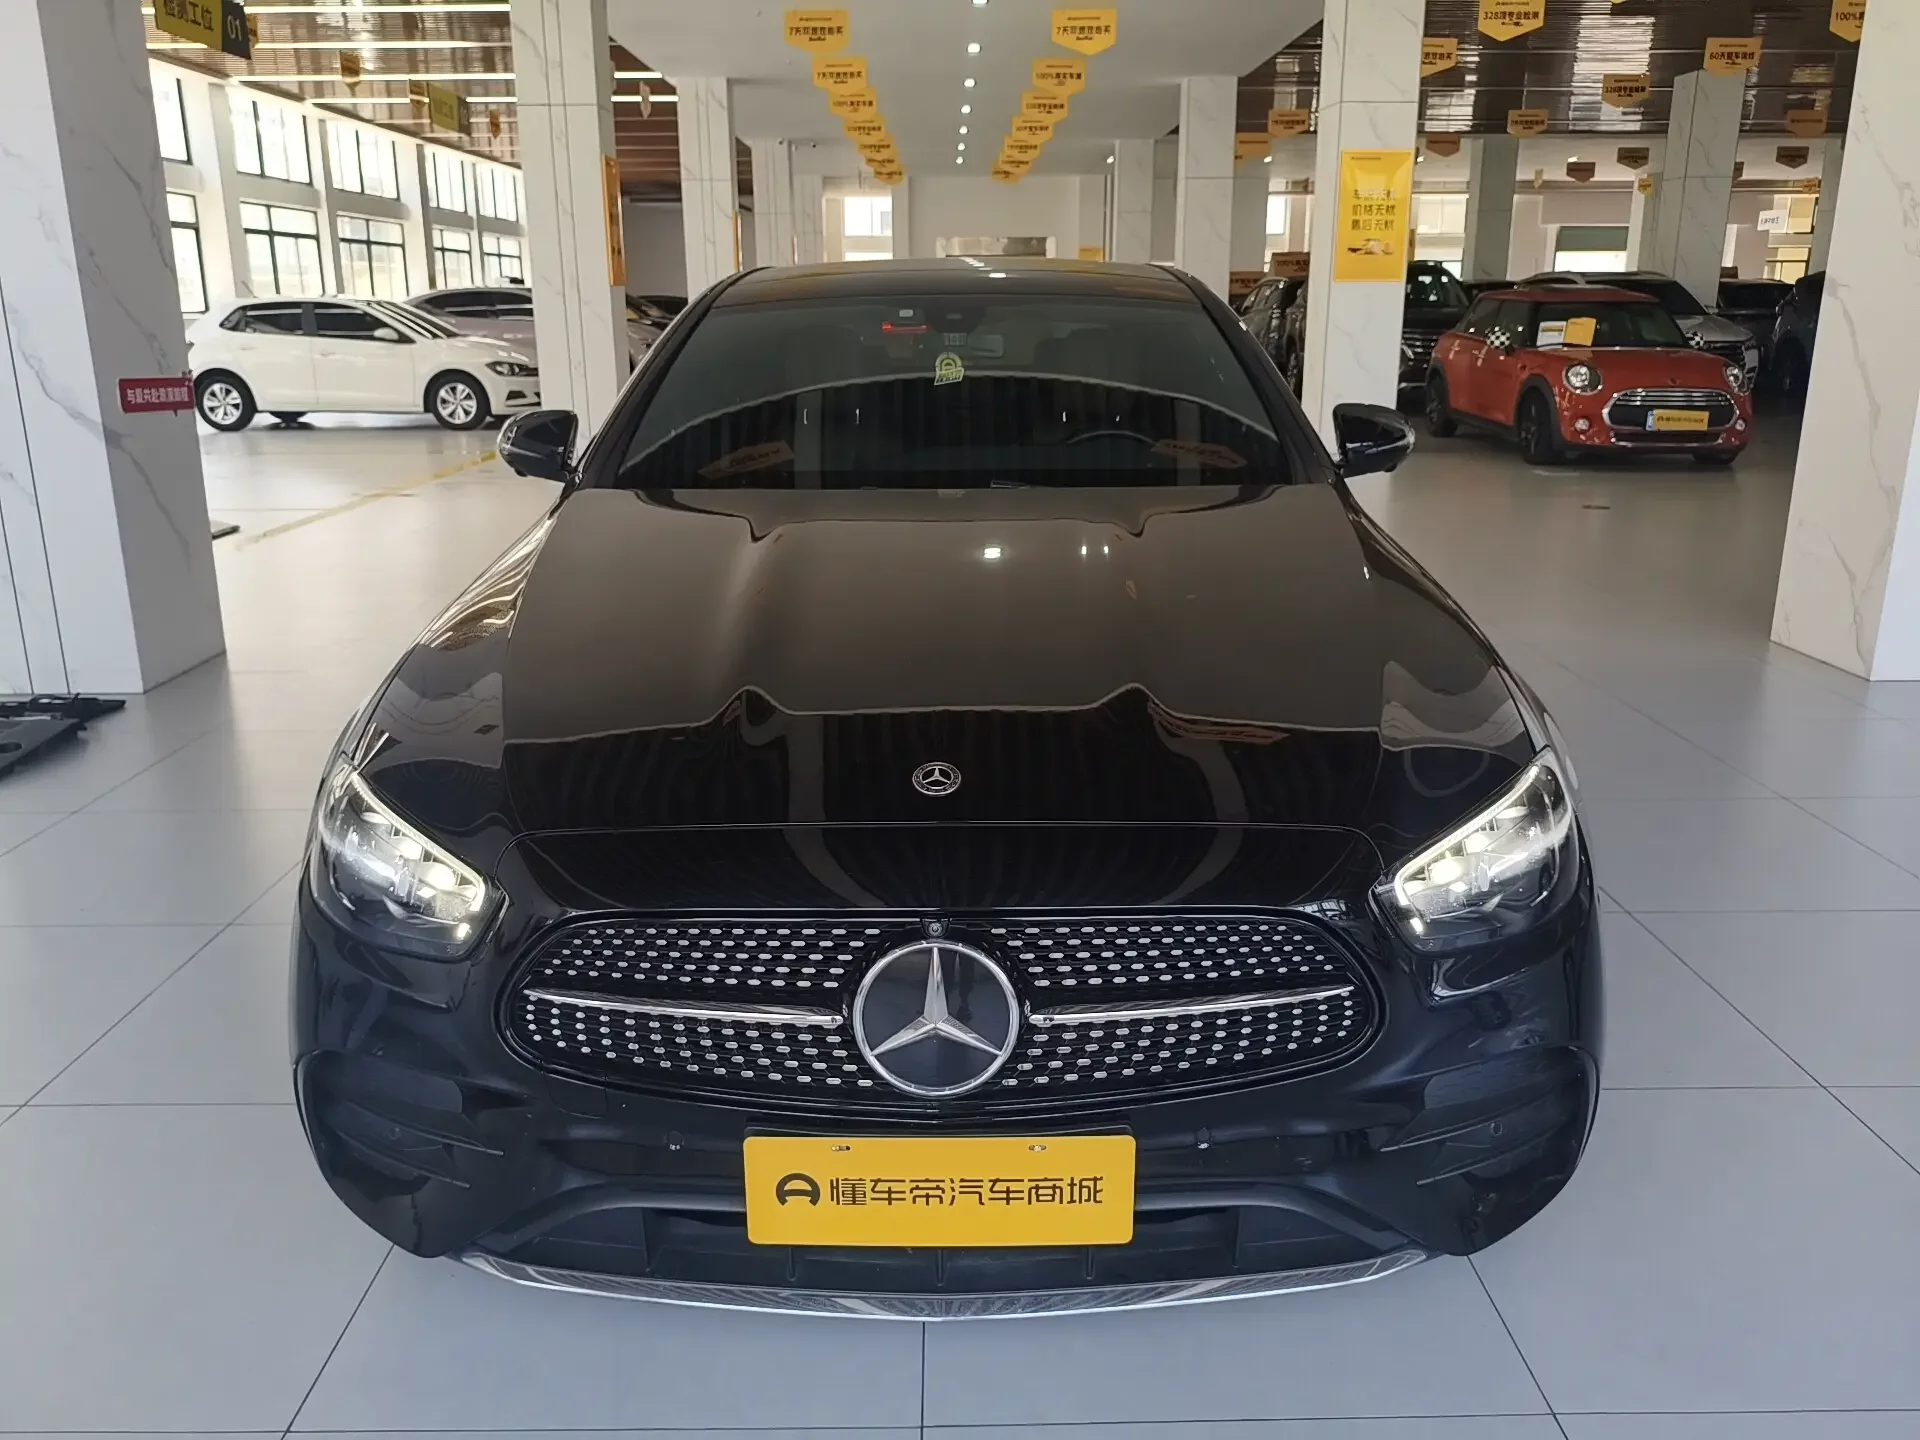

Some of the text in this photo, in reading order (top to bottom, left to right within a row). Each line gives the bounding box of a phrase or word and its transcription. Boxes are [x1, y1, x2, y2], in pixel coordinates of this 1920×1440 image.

[227, 14, 242, 42] 01
[829, 1175, 1104, 1207] 懂车帝汽车商城
